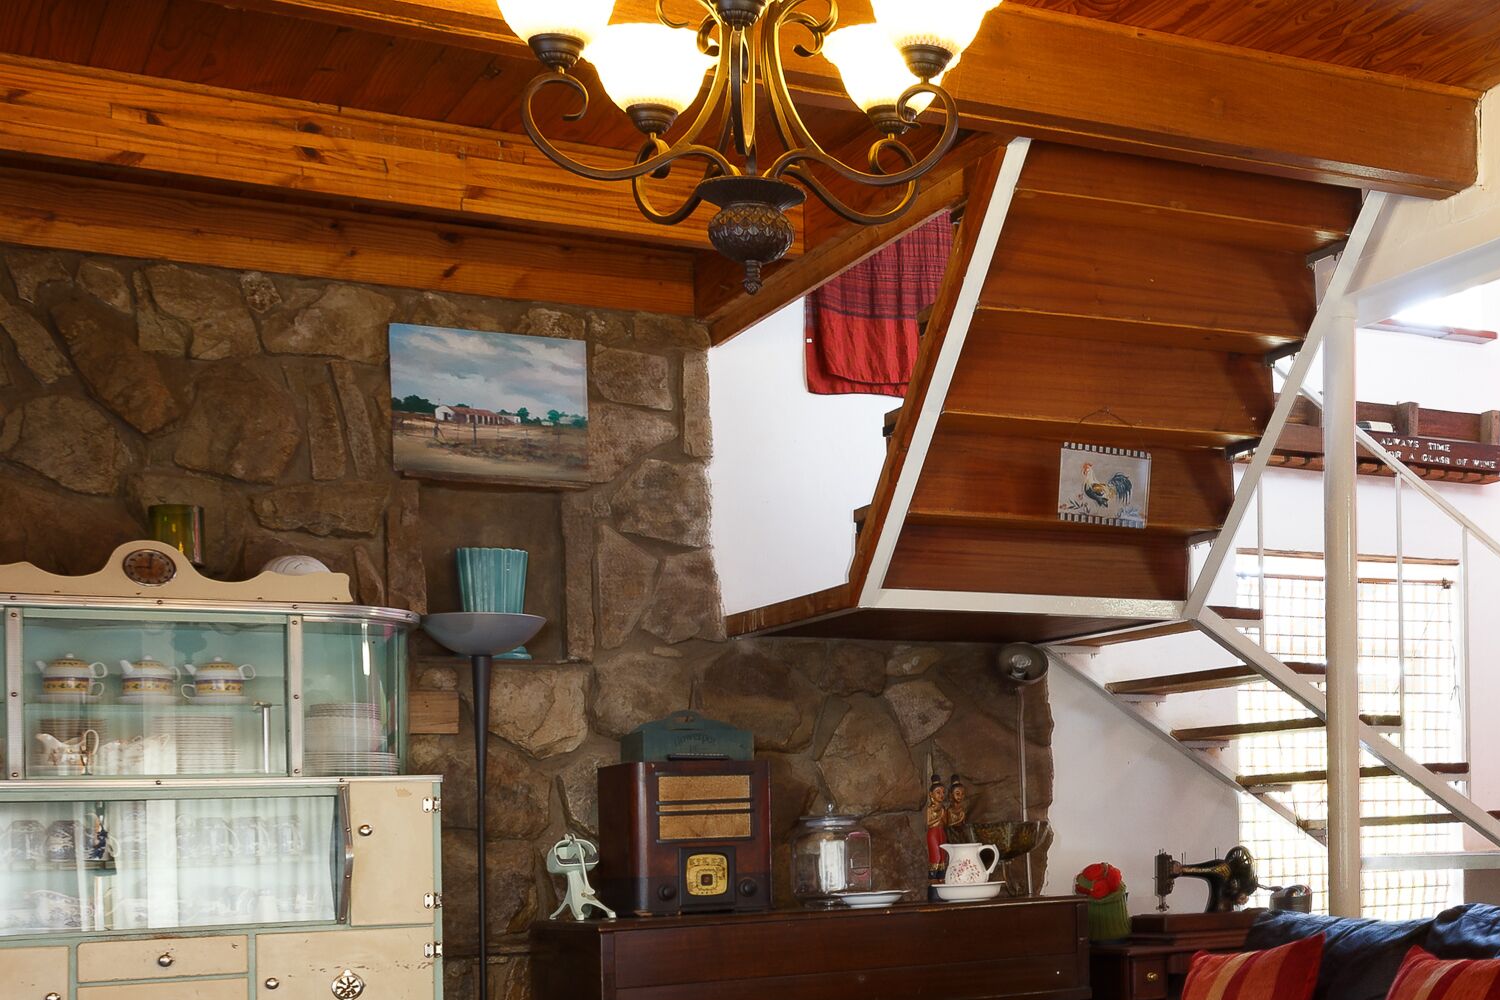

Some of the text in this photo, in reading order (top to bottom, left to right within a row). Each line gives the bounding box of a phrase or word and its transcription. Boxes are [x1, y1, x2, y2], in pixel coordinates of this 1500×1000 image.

[1380, 437, 1451, 453] ALWAYS TIME
[1421, 453, 1450, 465] GLASS
[1456, 458, 1468, 466] OF
[1473, 459, 1496, 469] WINE
